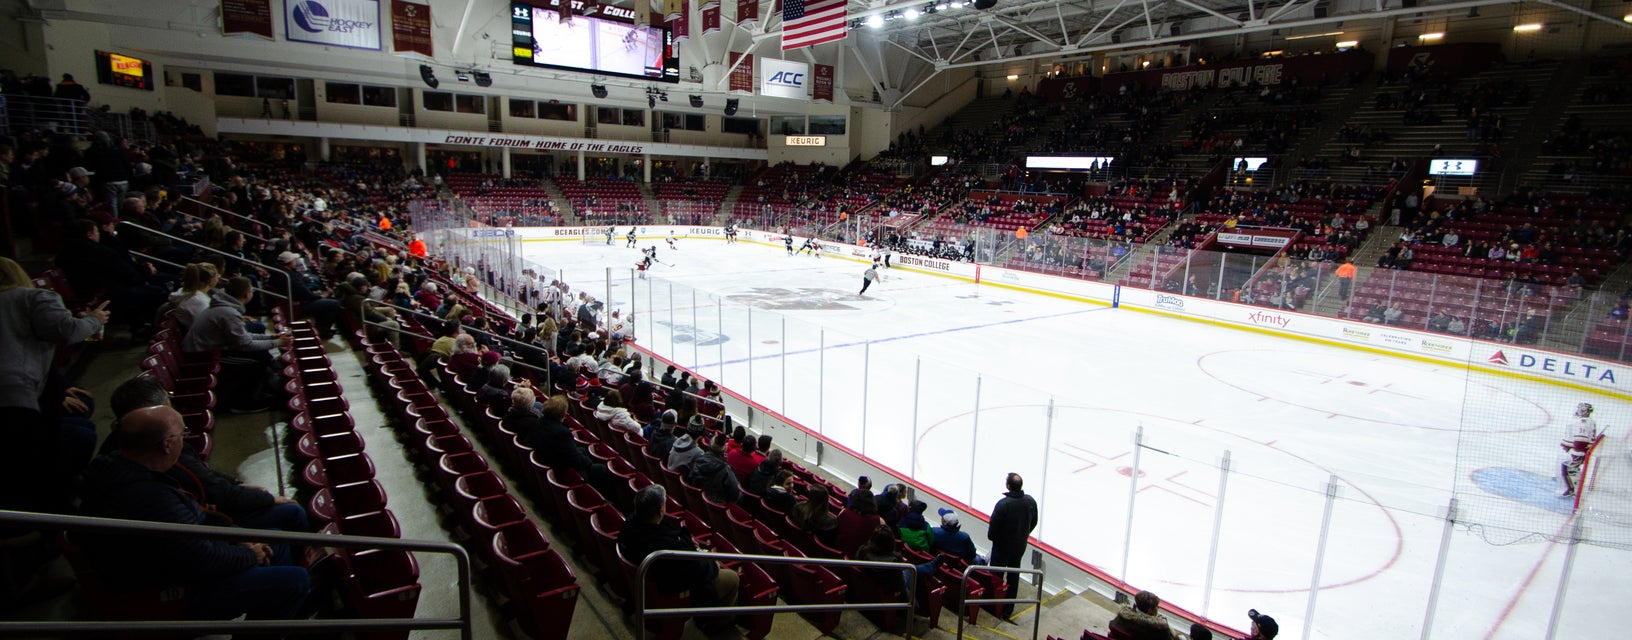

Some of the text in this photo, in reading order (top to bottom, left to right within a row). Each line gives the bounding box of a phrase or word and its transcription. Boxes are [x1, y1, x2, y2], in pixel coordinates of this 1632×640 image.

[328, 25, 355, 34] EAST
[329, 18, 373, 29] HOCKEY
[769, 71, 804, 85] ACC
[1162, 64, 1284, 91] BOSTON COLLEGE
[445, 135, 643, 153] CONTE FORUM HOME OF THE EAGLES
[790, 137, 820, 145] KEURIG
[900, 256, 950, 271] BOSTON COLLEGE
[1248, 311, 1291, 328] xfinity
[1520, 354, 1616, 384] DELTA
